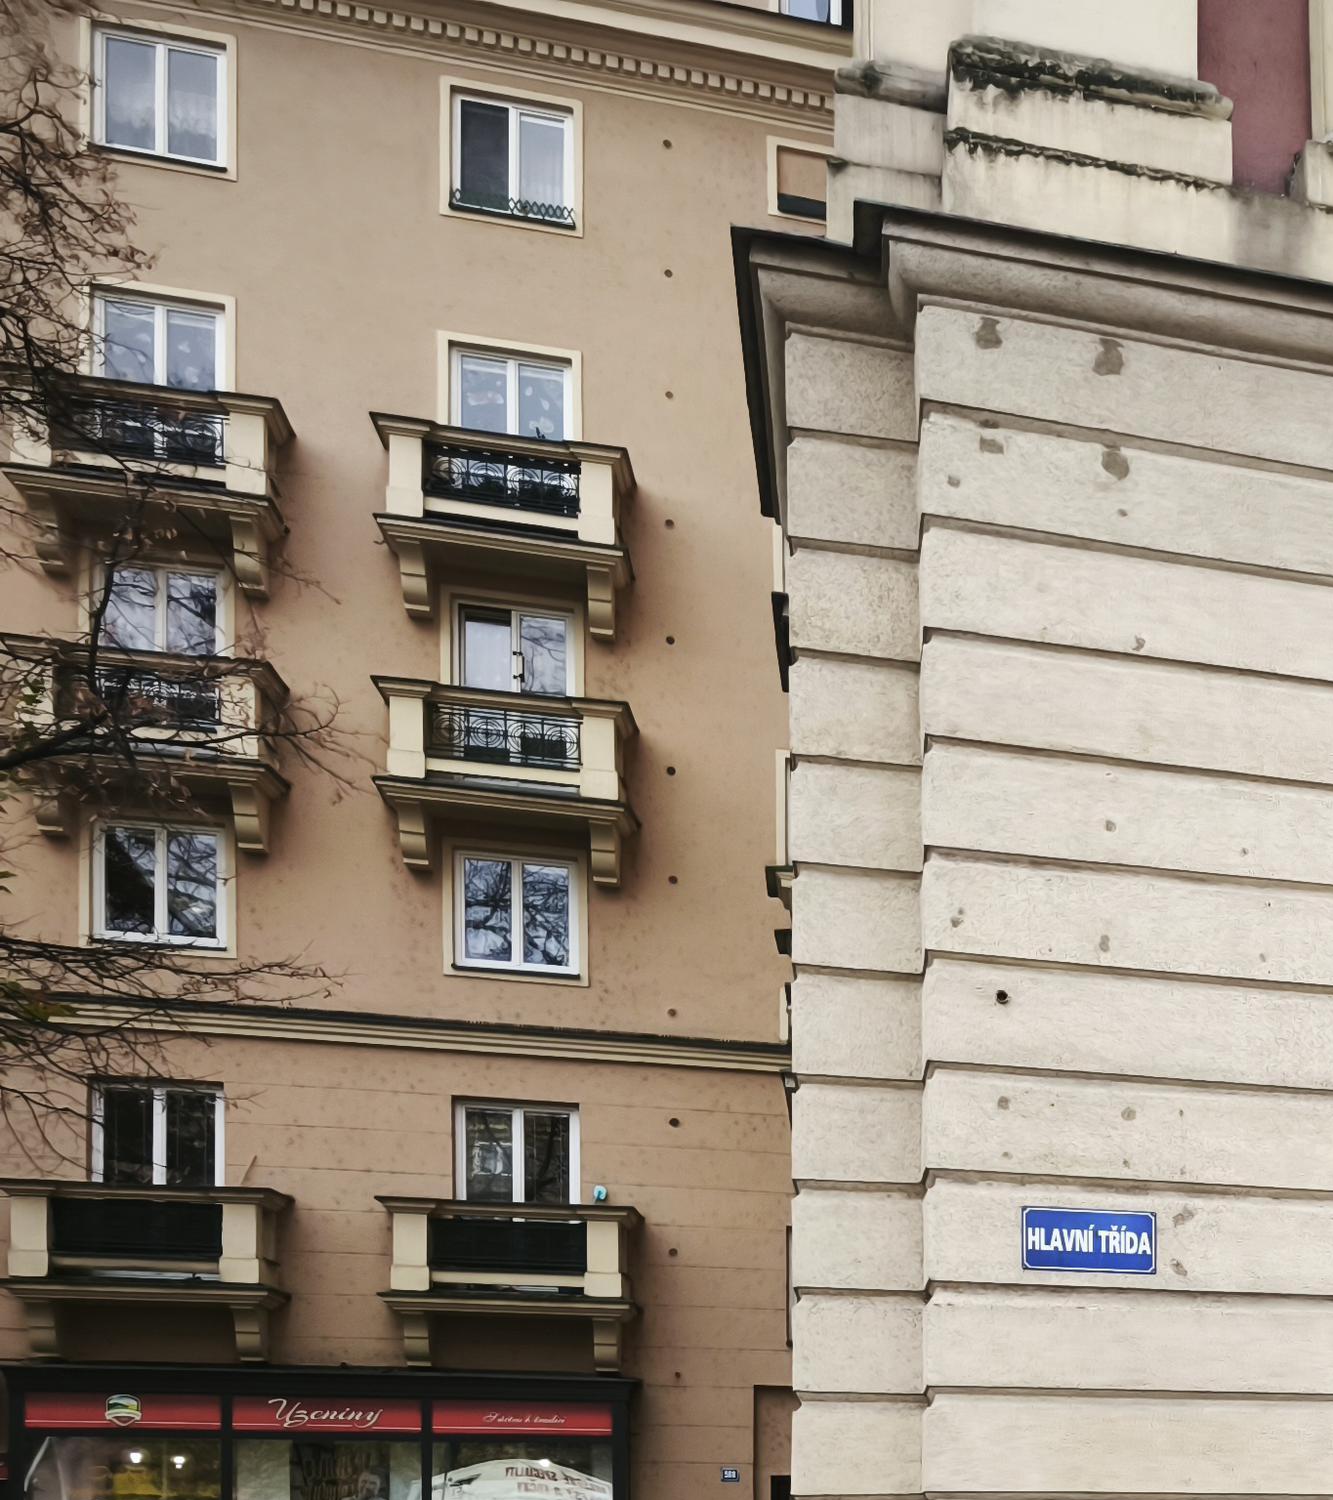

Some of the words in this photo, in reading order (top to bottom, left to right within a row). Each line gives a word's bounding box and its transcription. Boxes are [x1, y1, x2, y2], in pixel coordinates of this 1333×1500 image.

[1028, 1224, 1095, 1253] HLAVNÍ
[1098, 1225, 1152, 1255] TŘÍDA
[268, 1398, 384, 1429] Uzeniny
